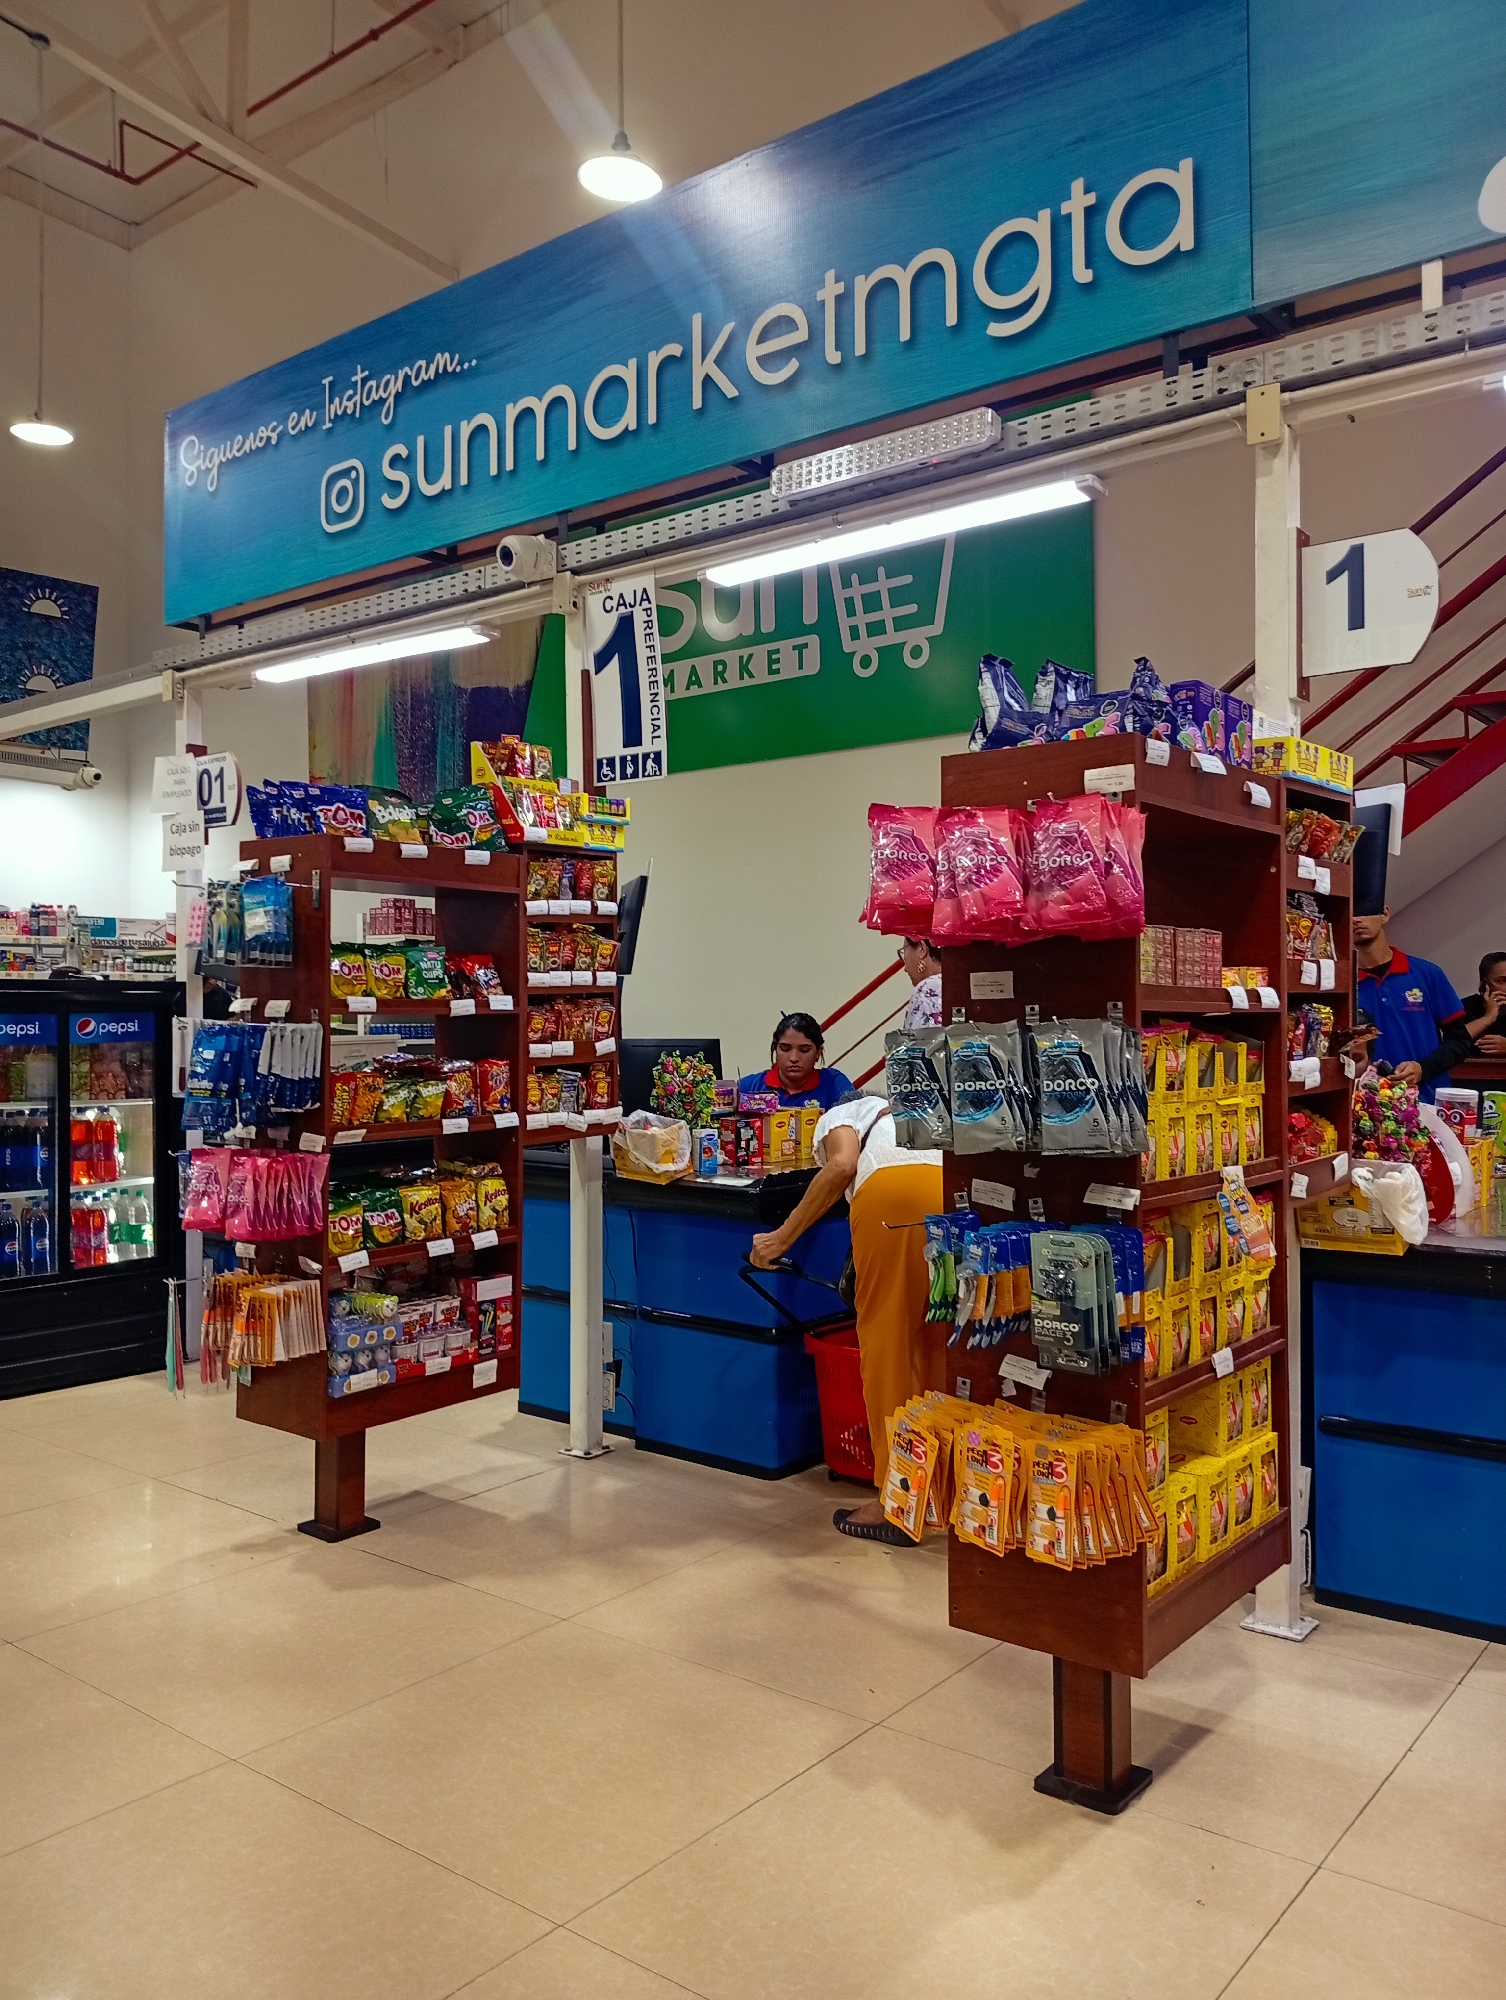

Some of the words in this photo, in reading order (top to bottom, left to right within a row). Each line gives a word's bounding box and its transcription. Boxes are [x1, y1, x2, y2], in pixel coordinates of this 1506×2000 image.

[380, 156, 1196, 510] sunmarketmgta
[179, 420, 284, 493] Siguenos
[287, 407, 317, 436] en
[1325, 542, 1365, 631] 1
[602, 587, 652, 614] CAJA
[593, 610, 643, 749] 1
[641, 607, 662, 746] PREFERENCIAL
[198, 766, 225, 807] 01
[170, 822, 187, 837] Caja
[188, 820, 201, 832] sin
[169, 844, 202, 858] biopago
[876, 849, 930, 863] DORCO
[1038, 850, 1094, 869] DORCO
[420, 960, 441, 970] NATU
[422, 969, 444, 979] CHIPS
[99, 1020, 139, 1035] pepsi
[890, 1081, 941, 1094] DORCO
[954, 1079, 1007, 1092] DORCO
[1043, 1078, 1099, 1093] DORCO
[937, 1114, 944, 1124] 5
[1000, 1116, 1007, 1126] 5
[1092, 1118, 1100, 1128] 5
[1034, 1318, 1080, 1332] DORCO
[1035, 1328, 1064, 1338] PACE
[912, 1438, 928, 1464] 3
[988, 1449, 1004, 1474] 3
[1053, 1460, 1068, 1484] 3
